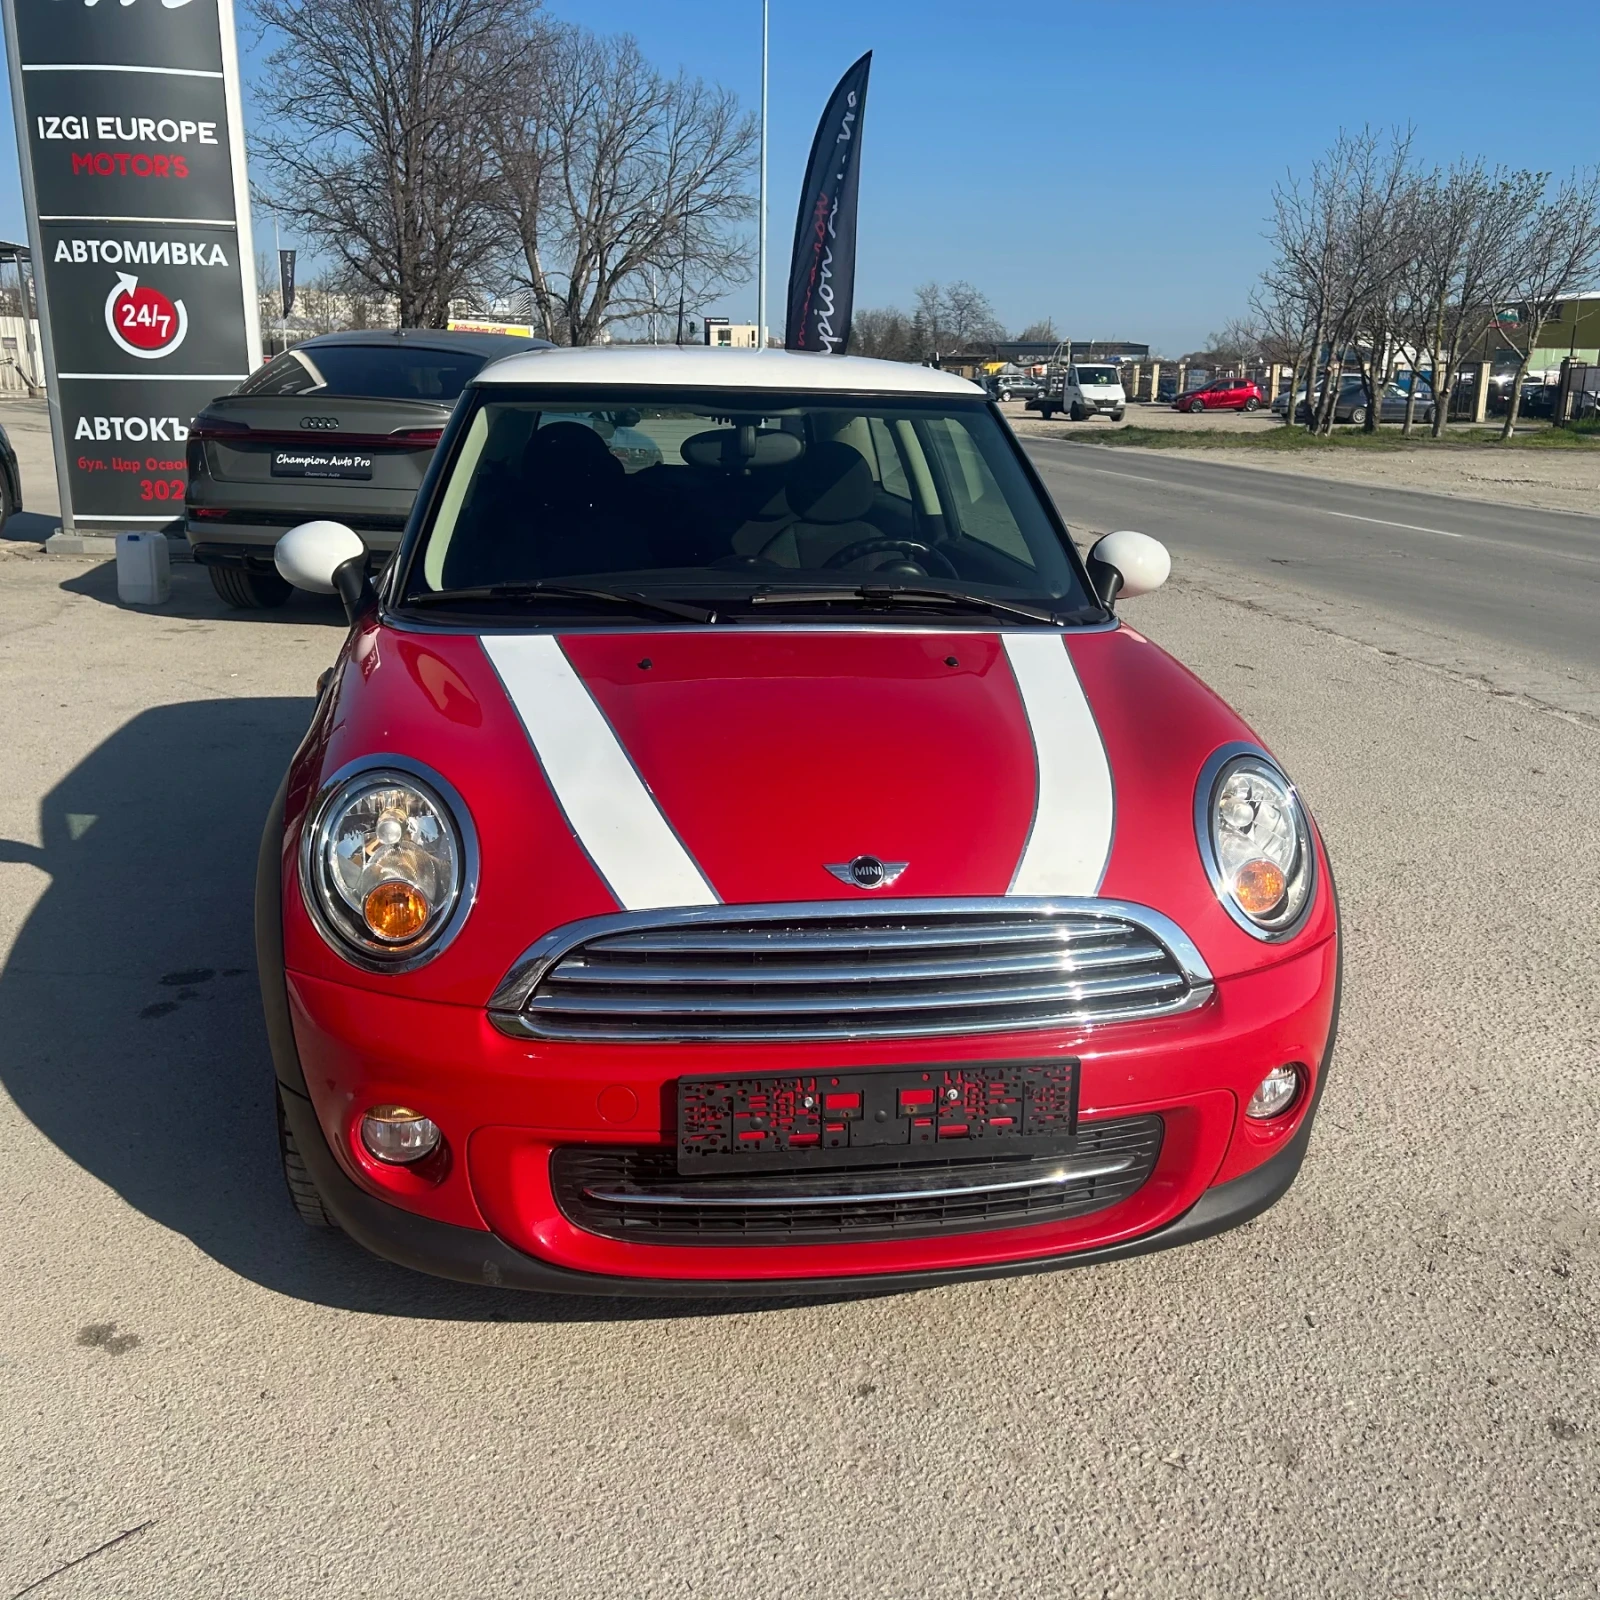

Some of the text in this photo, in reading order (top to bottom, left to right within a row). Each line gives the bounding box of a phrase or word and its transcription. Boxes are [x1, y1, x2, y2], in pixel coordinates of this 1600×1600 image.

[37, 116, 219, 144] IZGI EUROPE
[71, 152, 190, 178] MOTOR'S
[54, 239, 229, 267] АВТОМИВКА
[121, 303, 171, 338] 24/7
[74, 416, 196, 442] АВТОКЪ
[77, 456, 188, 474] бул. Цар Осво
[276, 453, 371, 467] Champion Auto Pro
[854, 866, 882, 876] MINI
